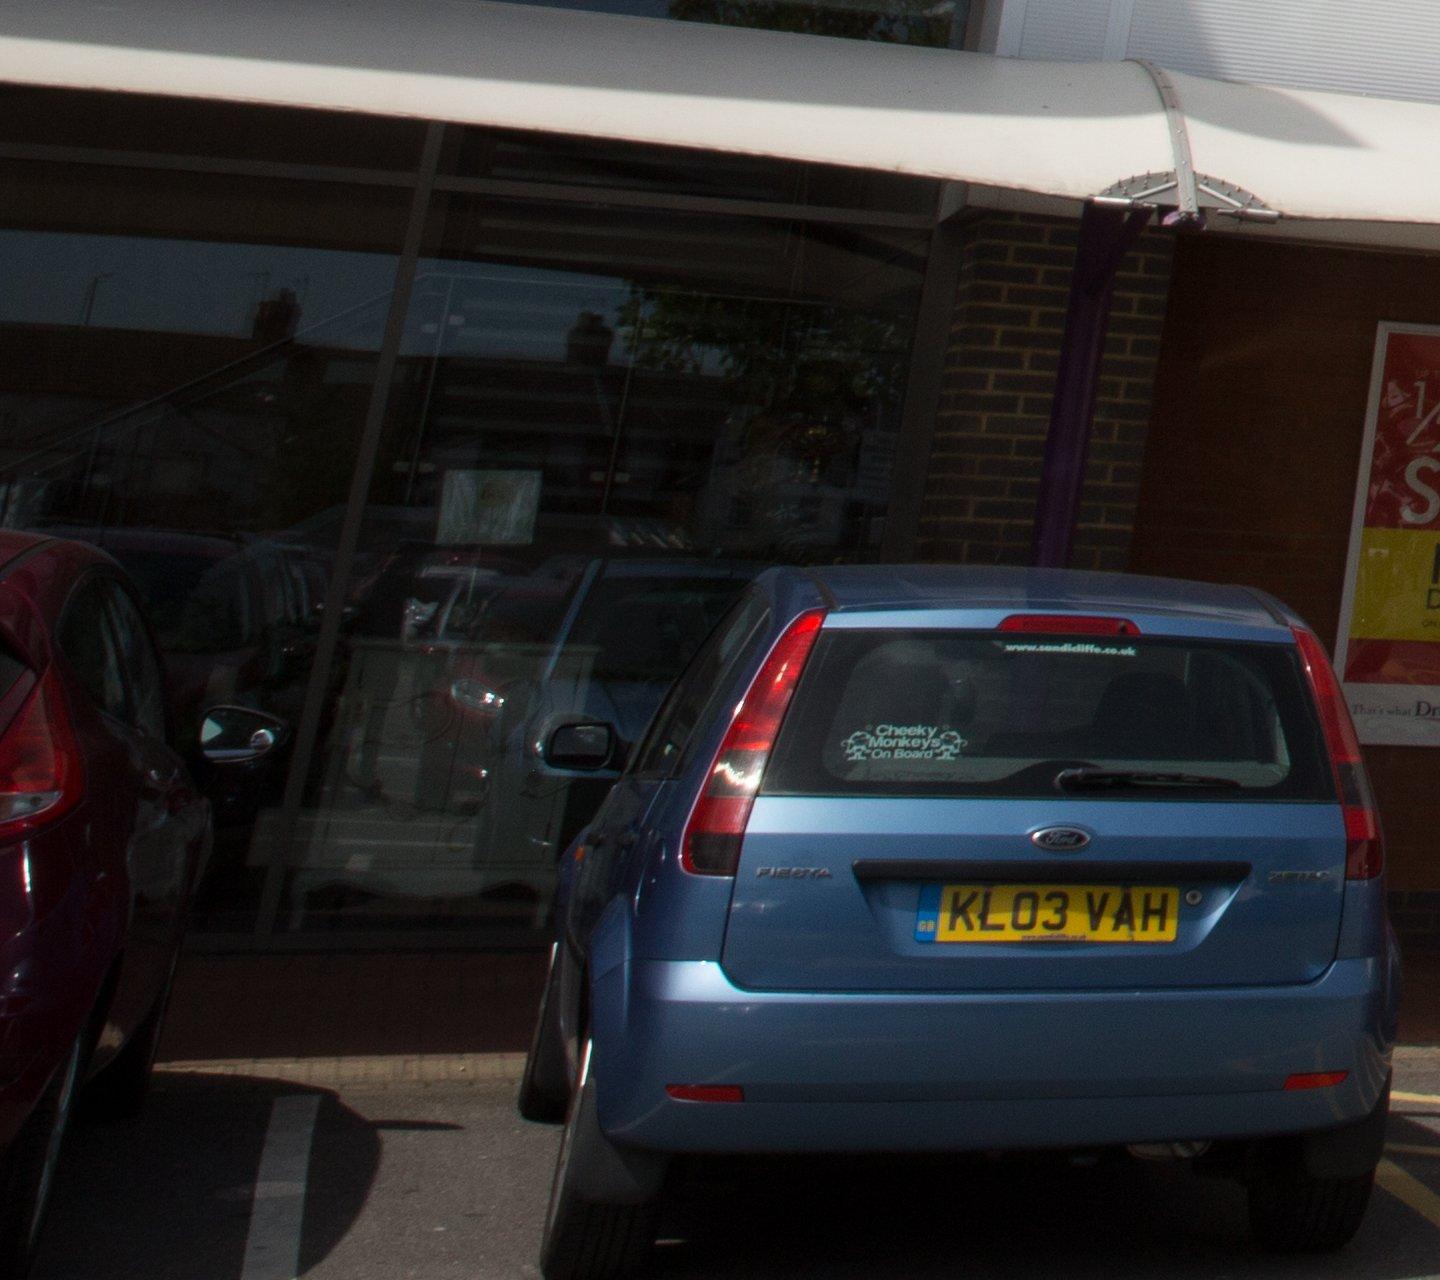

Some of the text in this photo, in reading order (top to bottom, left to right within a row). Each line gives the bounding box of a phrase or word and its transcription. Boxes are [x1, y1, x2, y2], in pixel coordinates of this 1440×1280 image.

[1385, 706, 1413, 718] what
[875, 724, 938, 736] Cheeky
[868, 736, 941, 749] Monkeys
[871, 750, 933, 759] On Board
[948, 890, 1169, 932] KL03 VAH
